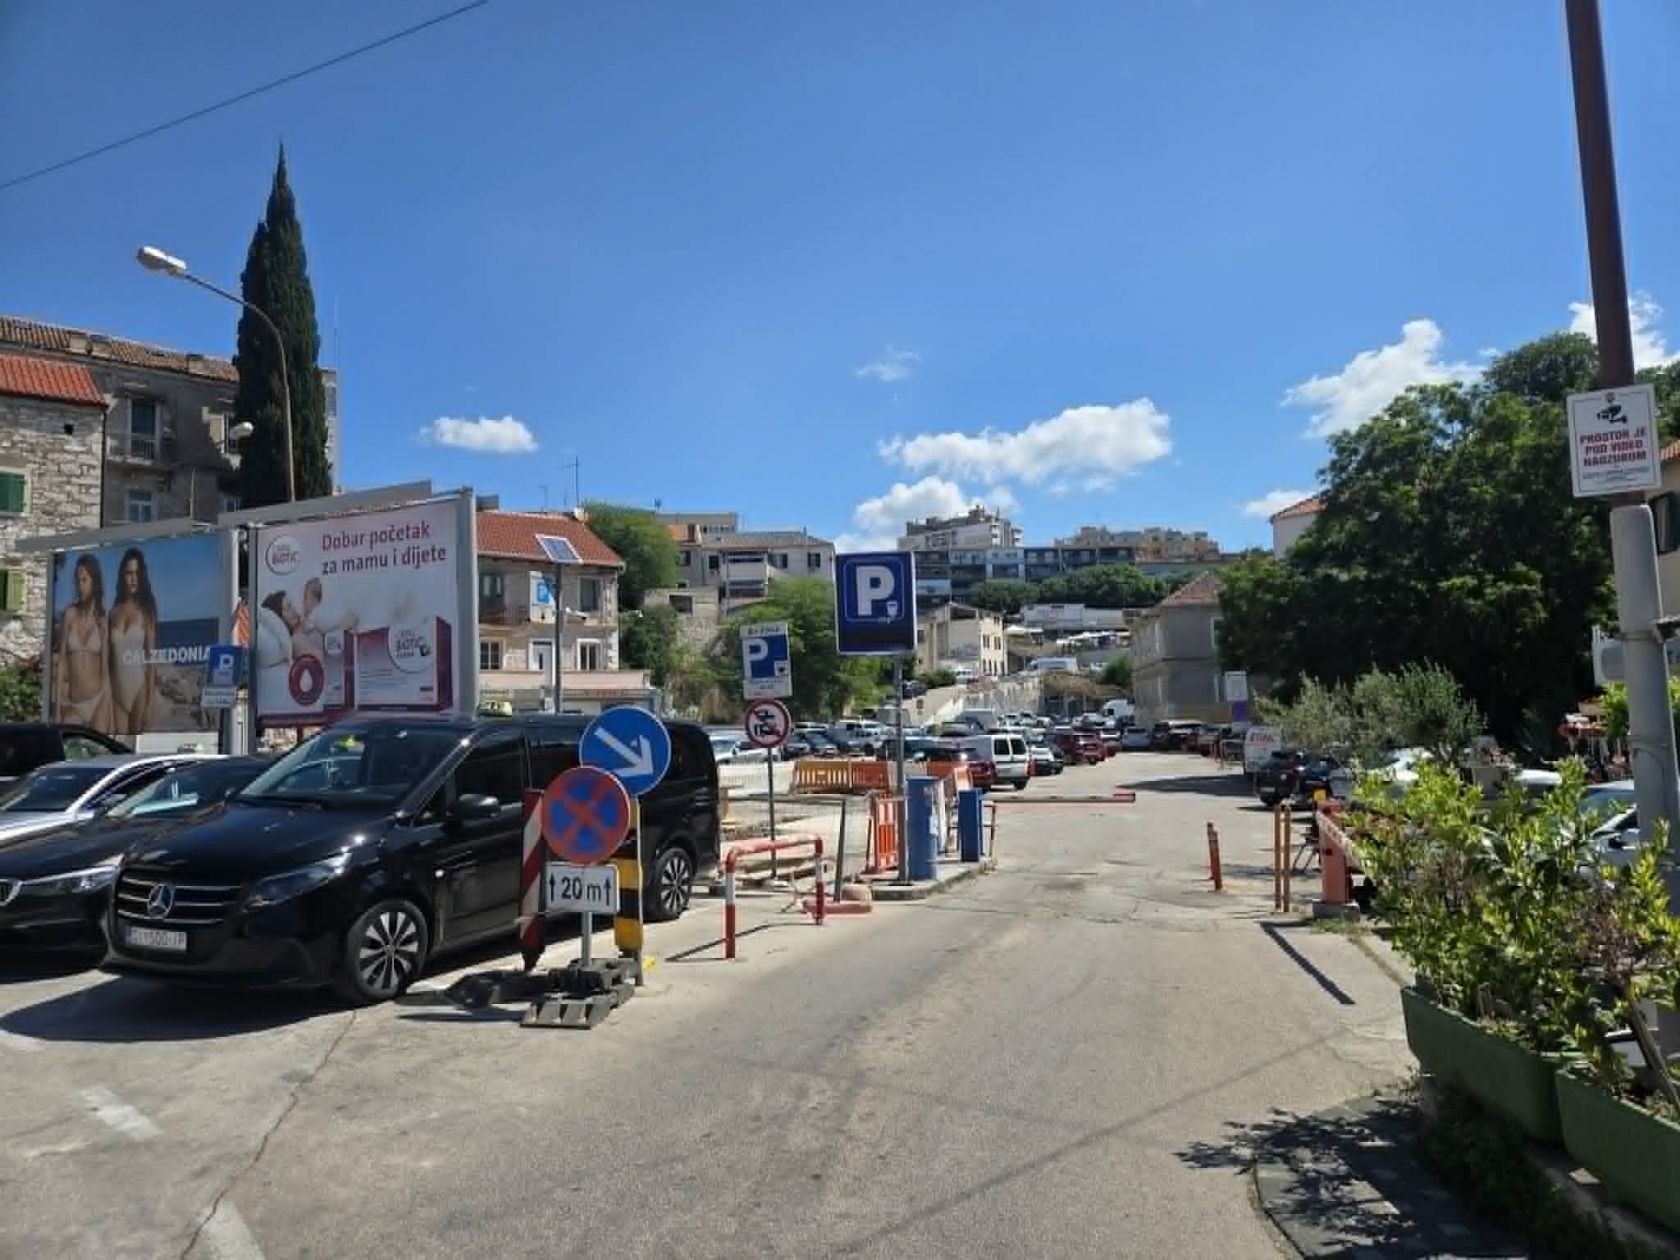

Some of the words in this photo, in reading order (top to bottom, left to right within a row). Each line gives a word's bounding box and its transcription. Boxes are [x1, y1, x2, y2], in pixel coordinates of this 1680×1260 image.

[1580, 429, 1630, 444] PROSTOR
[1633, 426, 1646, 438] JE
[1585, 444, 1607, 456] POD
[1611, 439, 1643, 453] VIDEO
[321, 531, 364, 552] Dobar
[369, 520, 431, 551] početak
[322, 560, 338, 576] za
[342, 552, 388, 573] mamu
[393, 548, 398, 566] i
[402, 544, 447, 570] dijete
[856, 565, 895, 616] P
[743, 638, 768, 679] P
[561, 877, 583, 900] 20
[586, 884, 602, 900] m
